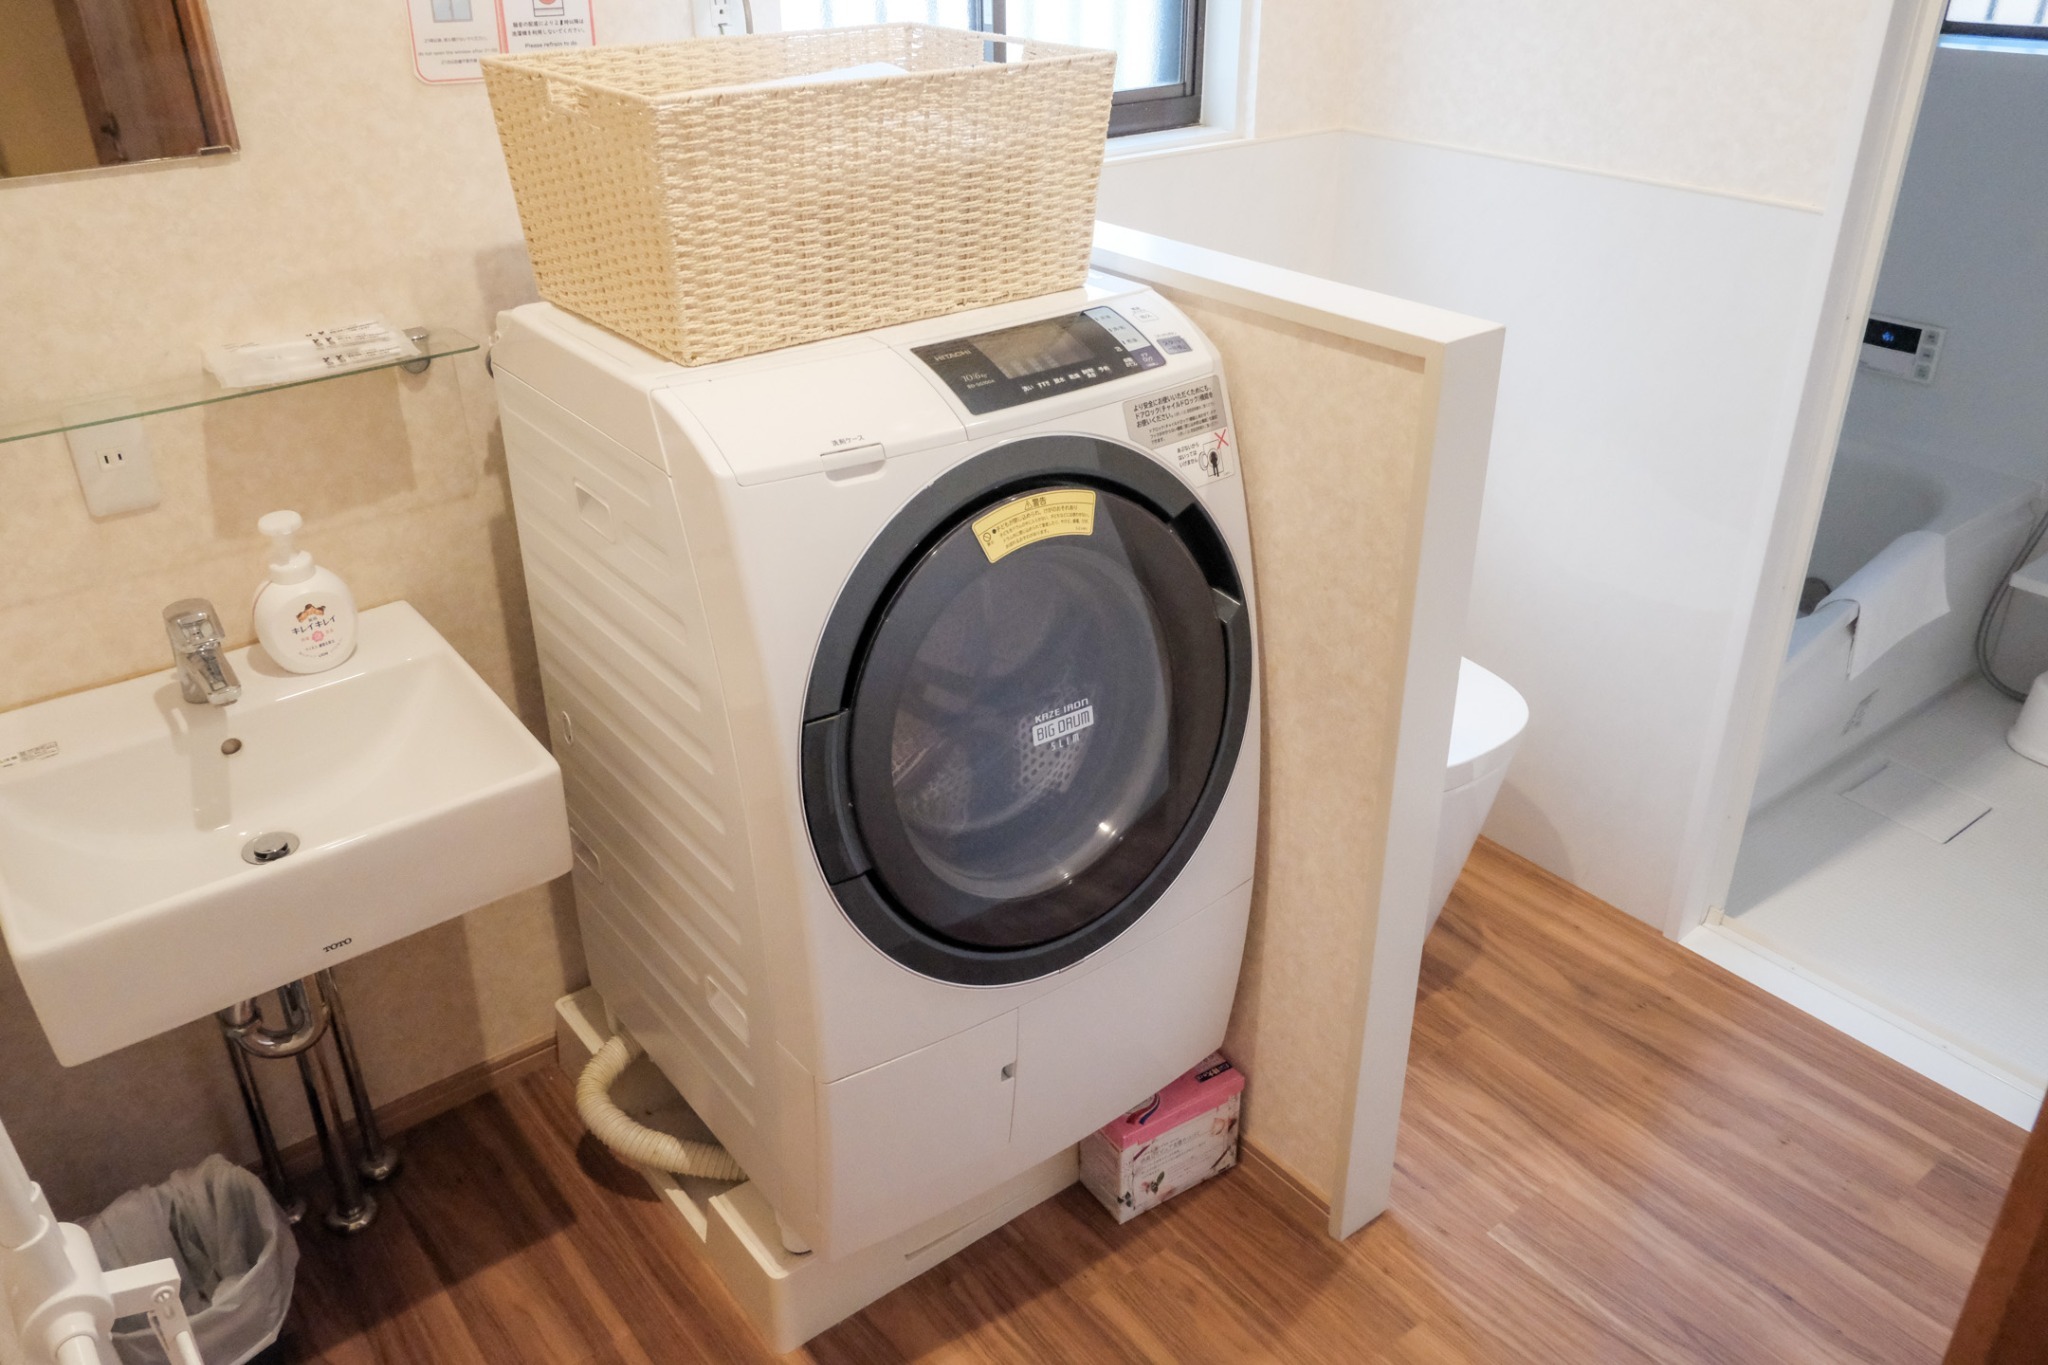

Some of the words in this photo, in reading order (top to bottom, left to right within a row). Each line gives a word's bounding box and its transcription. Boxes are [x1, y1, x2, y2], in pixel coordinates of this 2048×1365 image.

[934, 349, 972, 361] HITACHI
[1032, 497, 1047, 507] 警告
[292, 615, 335, 634] キレイキレイ
[1034, 708, 1060, 724] KAZE
[1063, 698, 1089, 713] IRON
[1036, 723, 1056, 741] BIG
[1058, 710, 1091, 733] DRUM
[323, 938, 352, 952] TOTO
